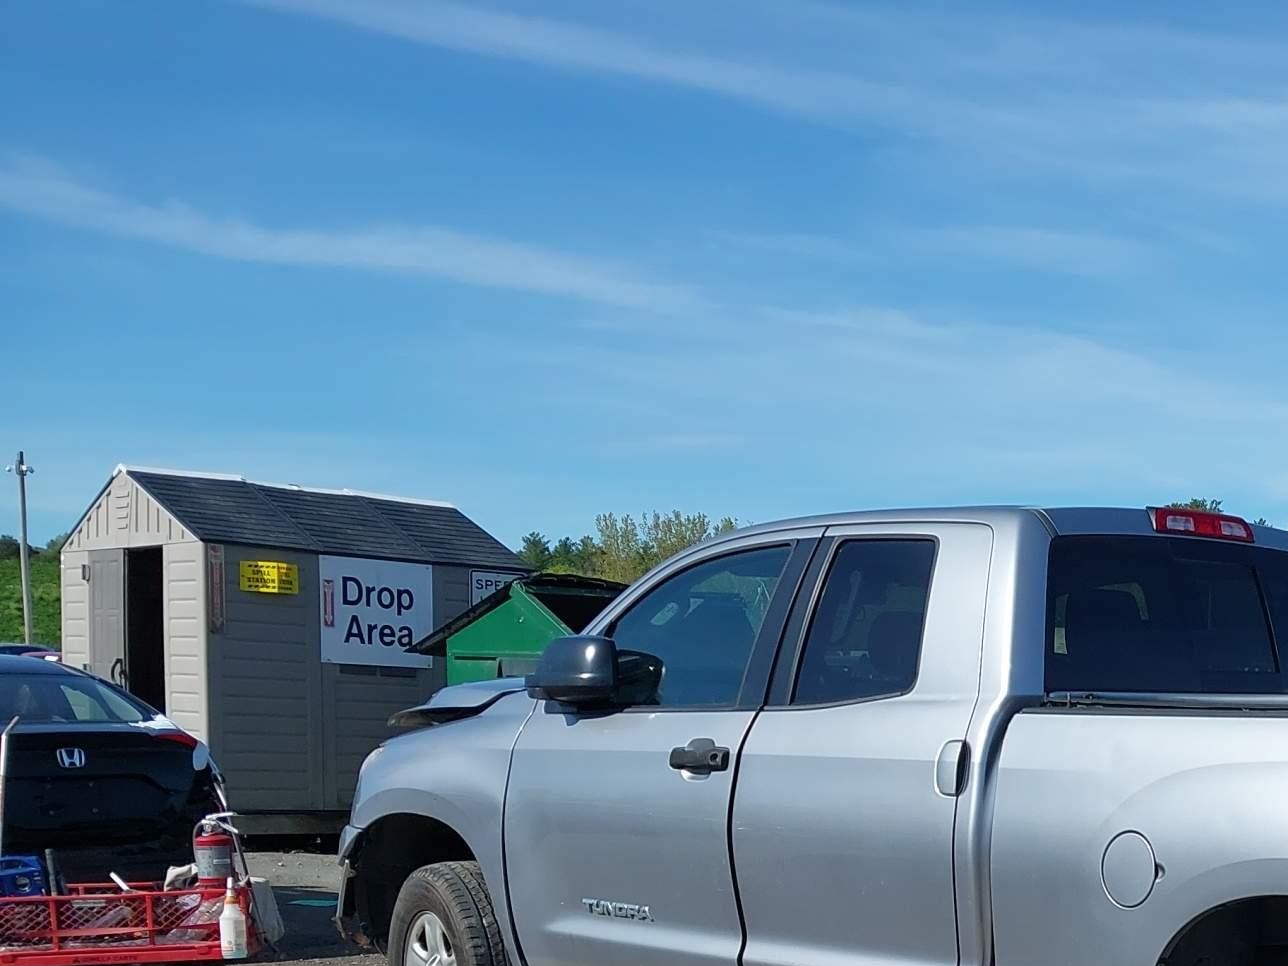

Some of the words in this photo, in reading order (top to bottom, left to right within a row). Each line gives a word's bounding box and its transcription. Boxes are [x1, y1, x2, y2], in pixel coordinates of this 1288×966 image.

[342, 576, 414, 616] Drop
[475, 578, 511, 590] SPE
[344, 615, 413, 648] Area
[582, 898, 655, 922] TUNDRA
